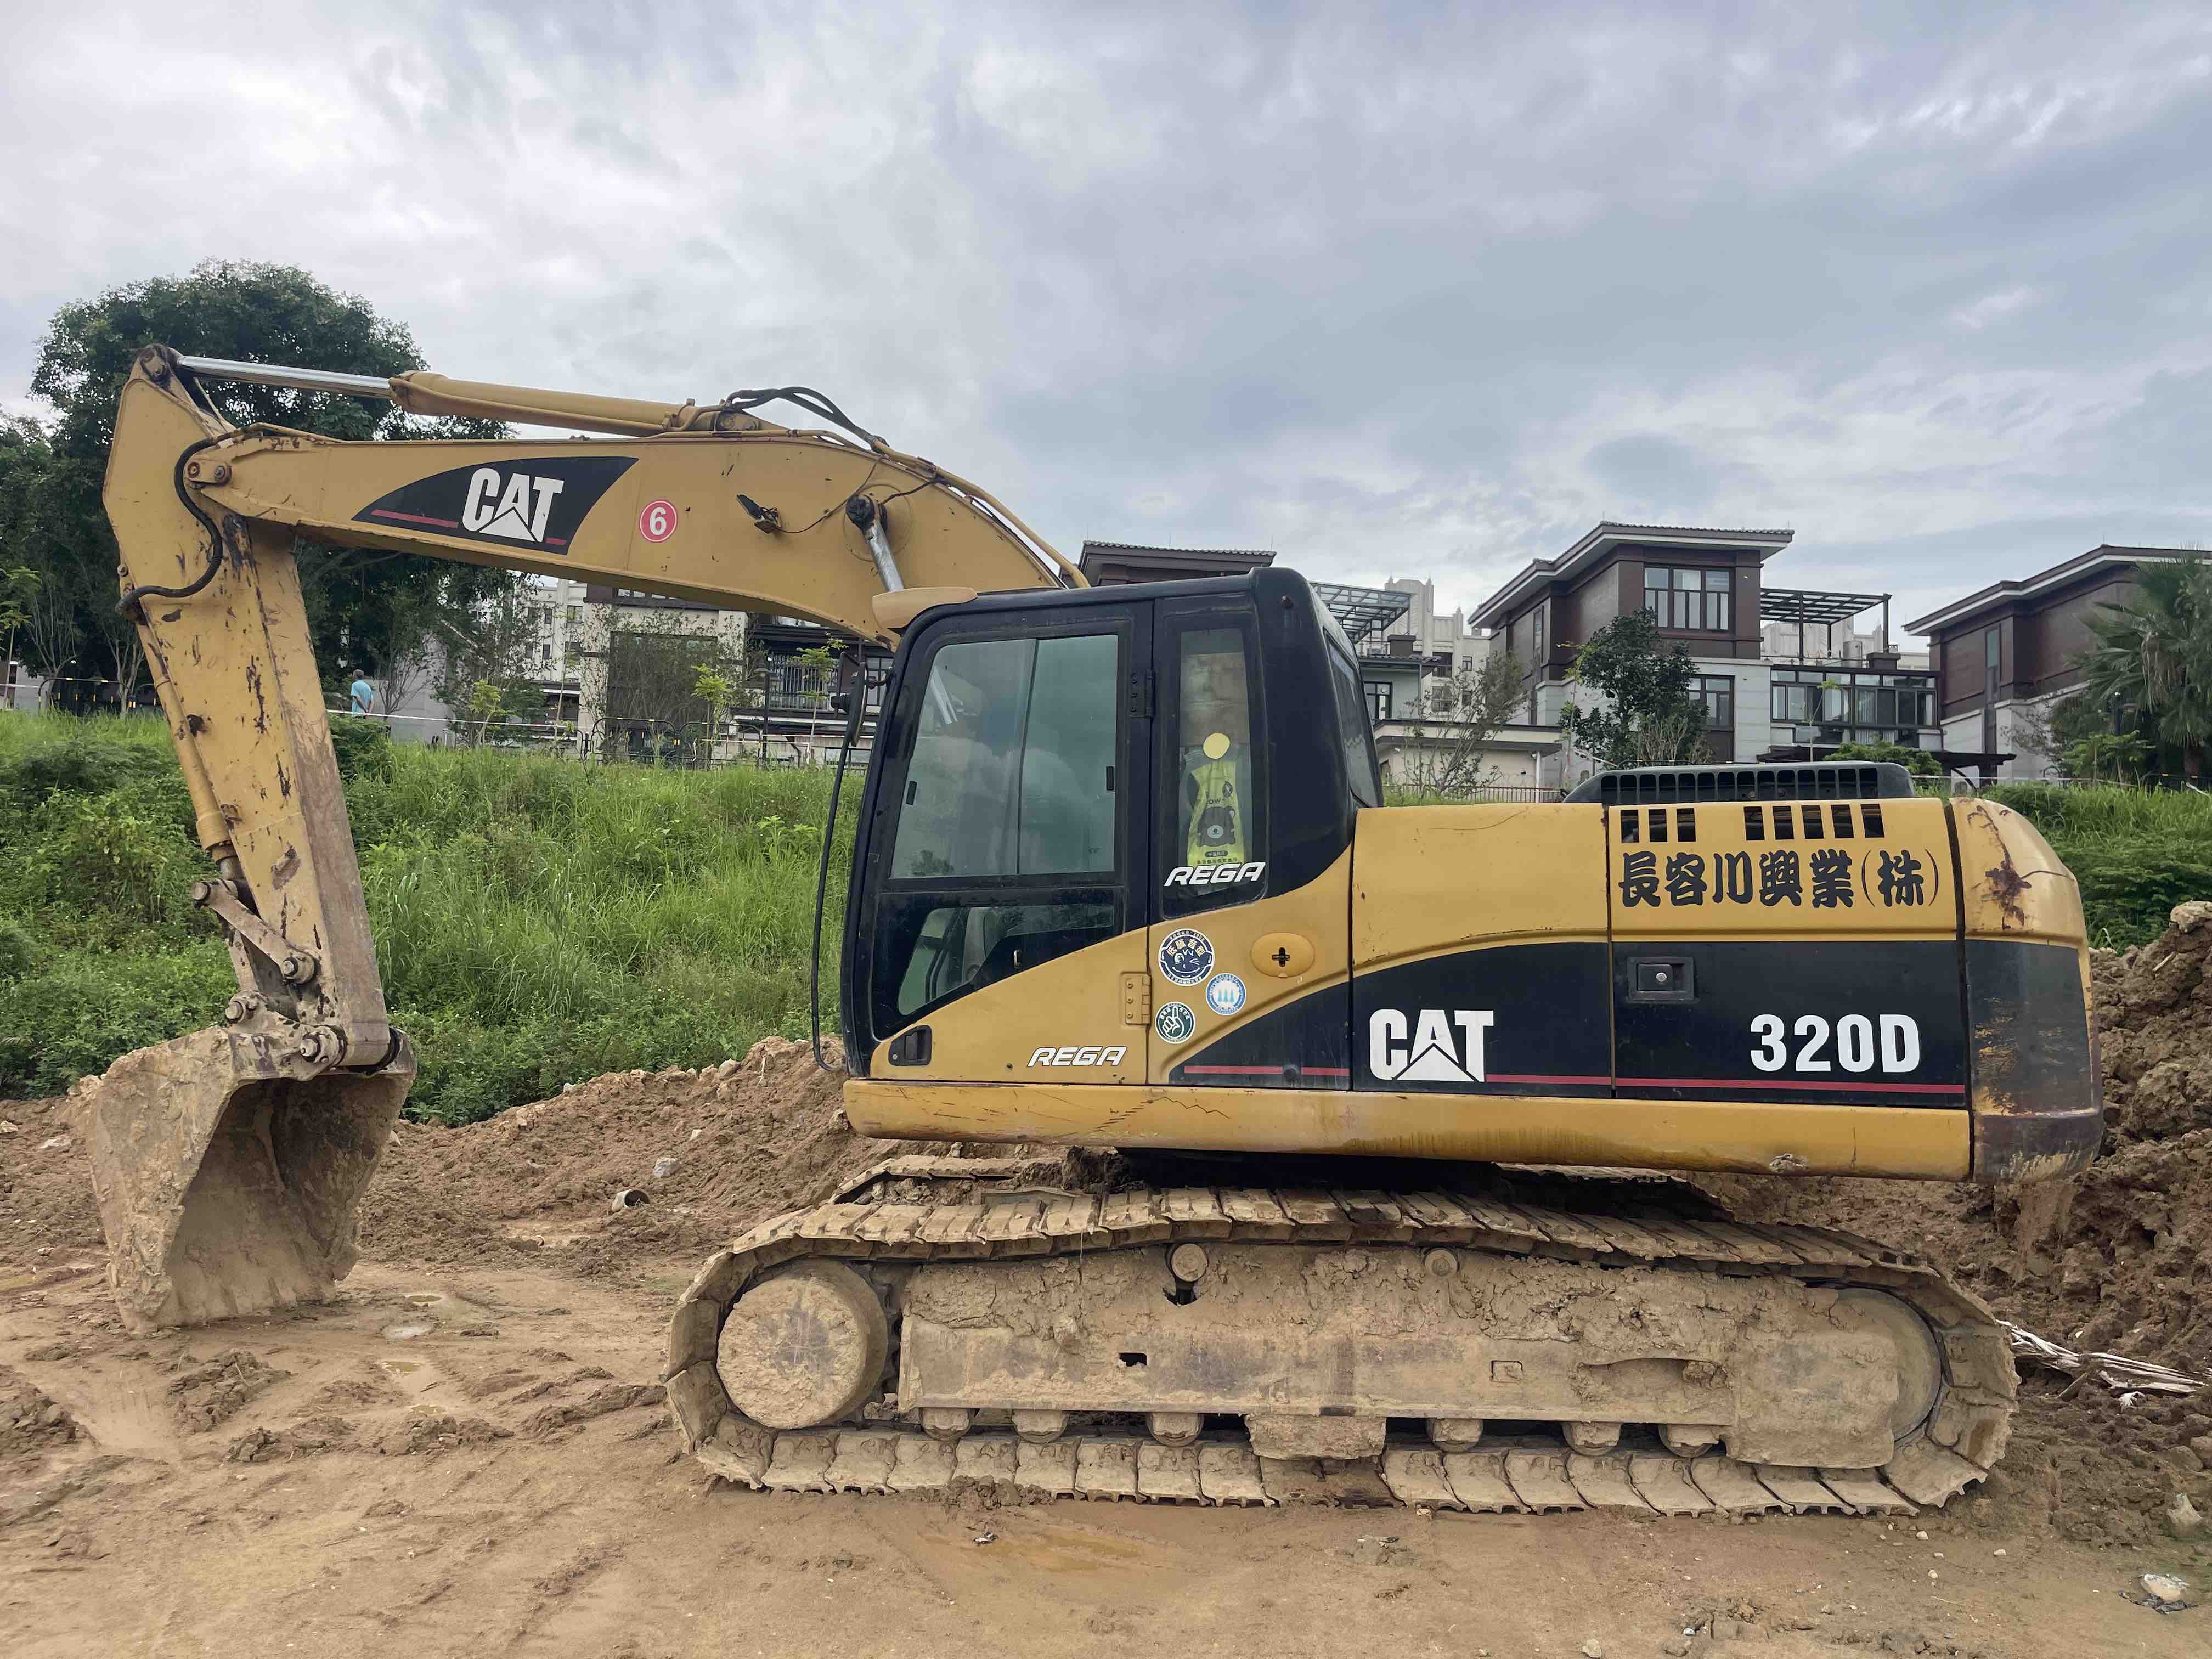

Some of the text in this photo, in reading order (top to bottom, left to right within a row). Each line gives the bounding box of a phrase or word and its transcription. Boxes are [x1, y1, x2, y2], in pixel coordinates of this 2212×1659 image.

[462, 467, 565, 543] CAT
[650, 506, 667, 536] 6
[1164, 861, 1266, 887] REGA
[1026, 1046, 1127, 1067] REGA
[1369, 1009, 1494, 1082] CAT
[1751, 1014, 1920, 1073] 320D
